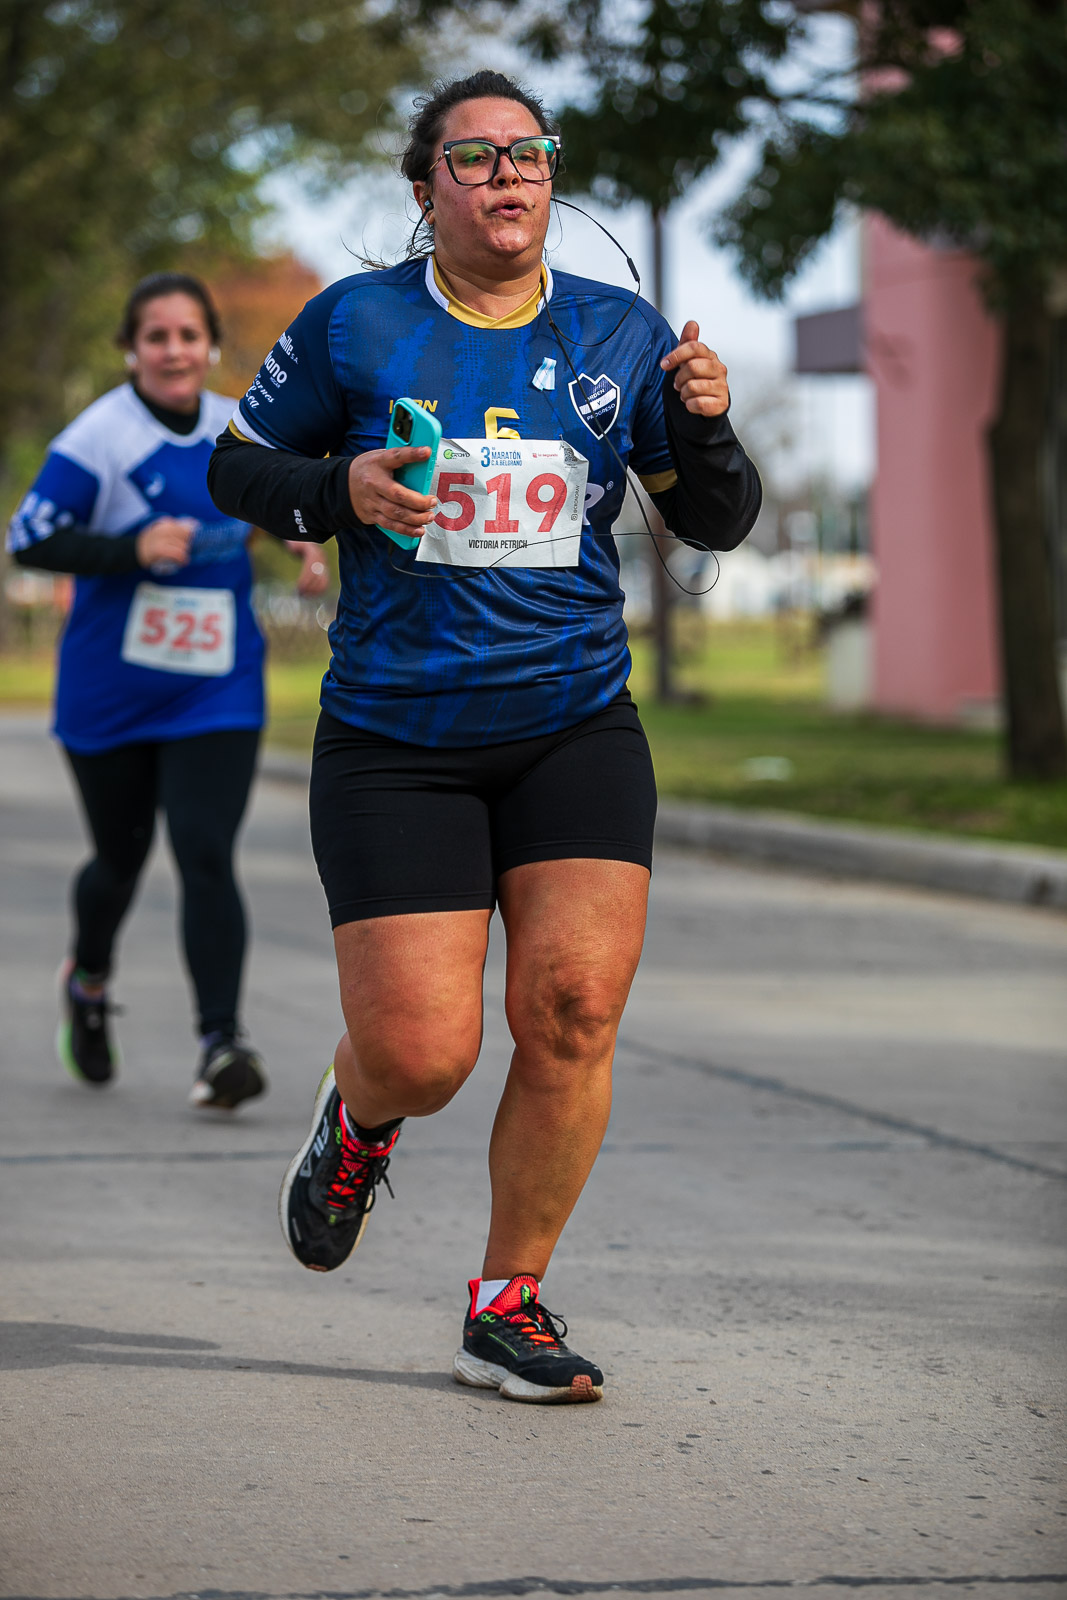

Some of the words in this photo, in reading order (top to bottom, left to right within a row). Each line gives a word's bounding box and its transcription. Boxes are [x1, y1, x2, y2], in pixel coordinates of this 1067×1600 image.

[480, 446, 490, 467] 3
[491, 450, 522, 460] MARATÓN
[434, 472, 568, 534] 519
[468, 539, 499, 550] VICTORIA
[500, 539, 528, 550] PETRICH
[139, 607, 224, 653] 525
[299, 1115, 330, 1178] FILA
